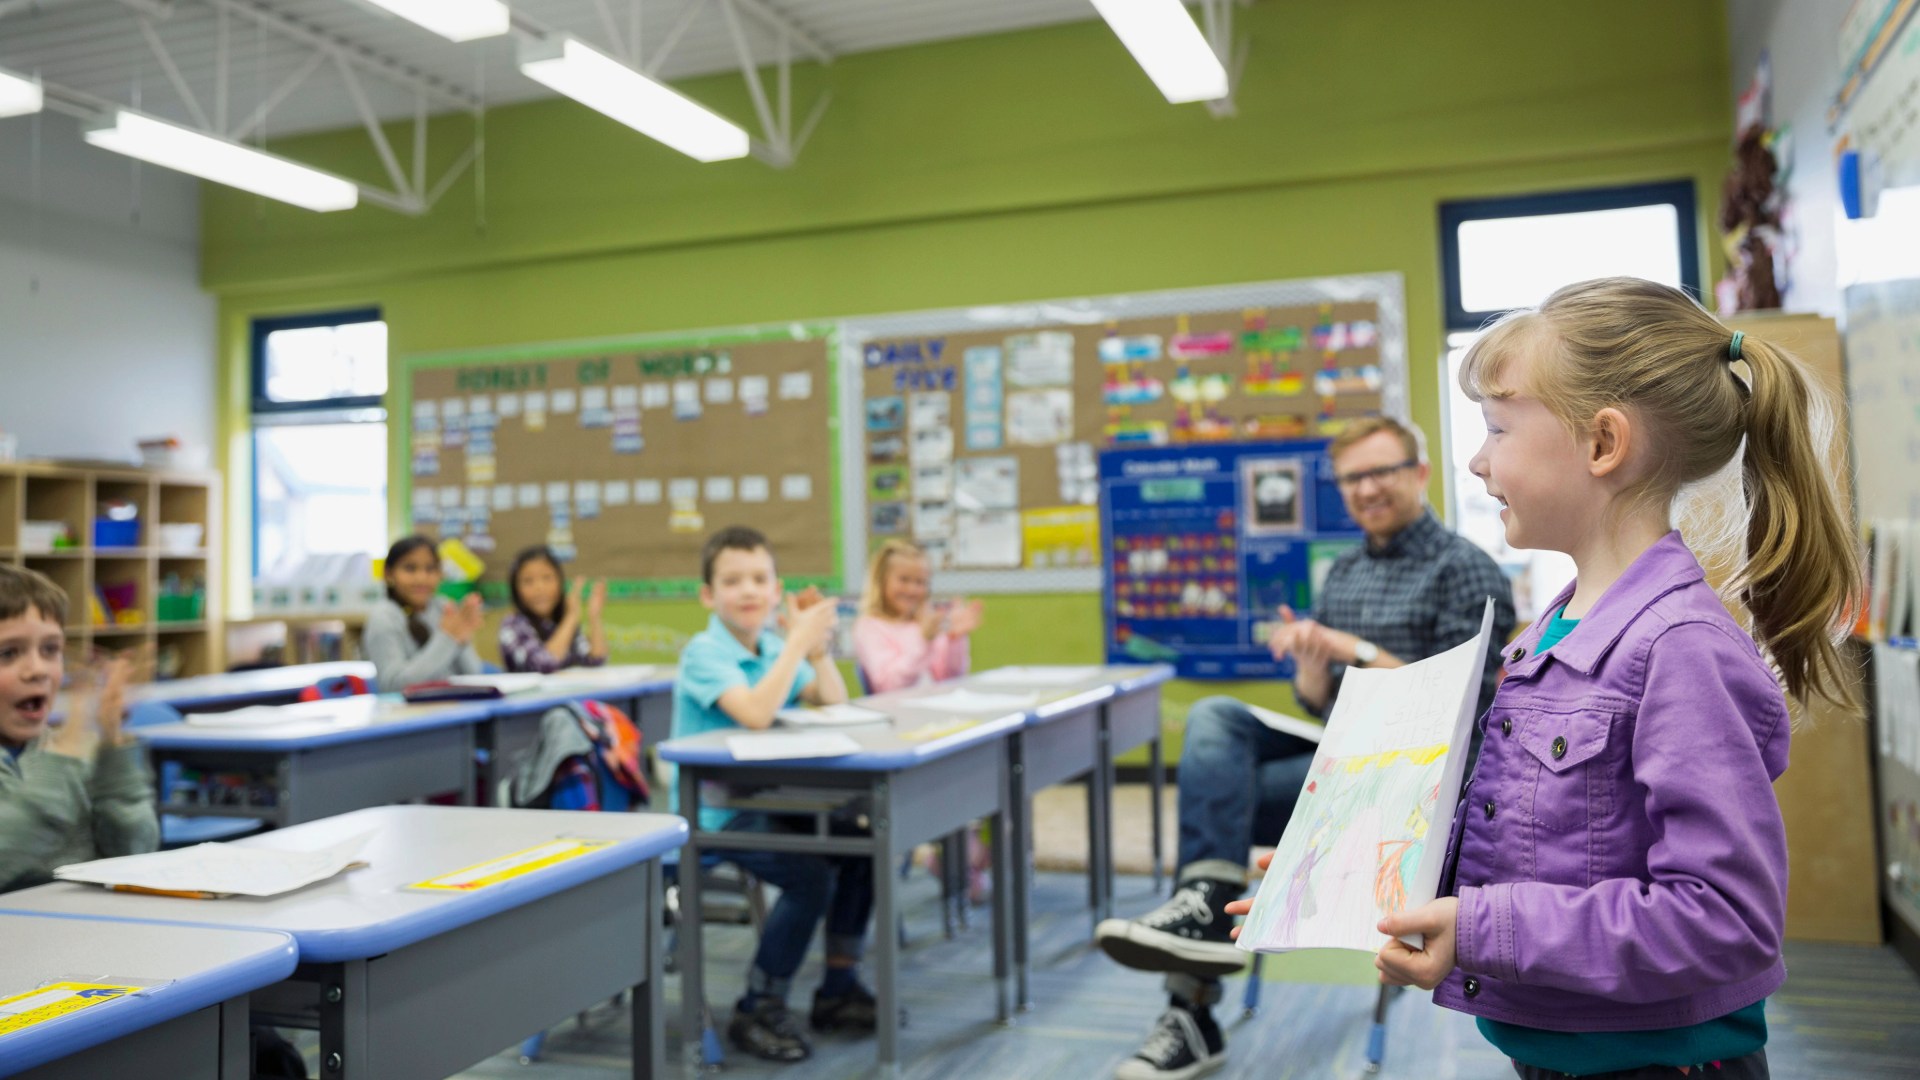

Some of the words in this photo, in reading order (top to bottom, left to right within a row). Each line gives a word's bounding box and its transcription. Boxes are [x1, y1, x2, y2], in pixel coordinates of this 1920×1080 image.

[863, 338, 946, 368] DAILY
[577, 357, 611, 385] OF
[895, 366, 957, 392] FIVE
